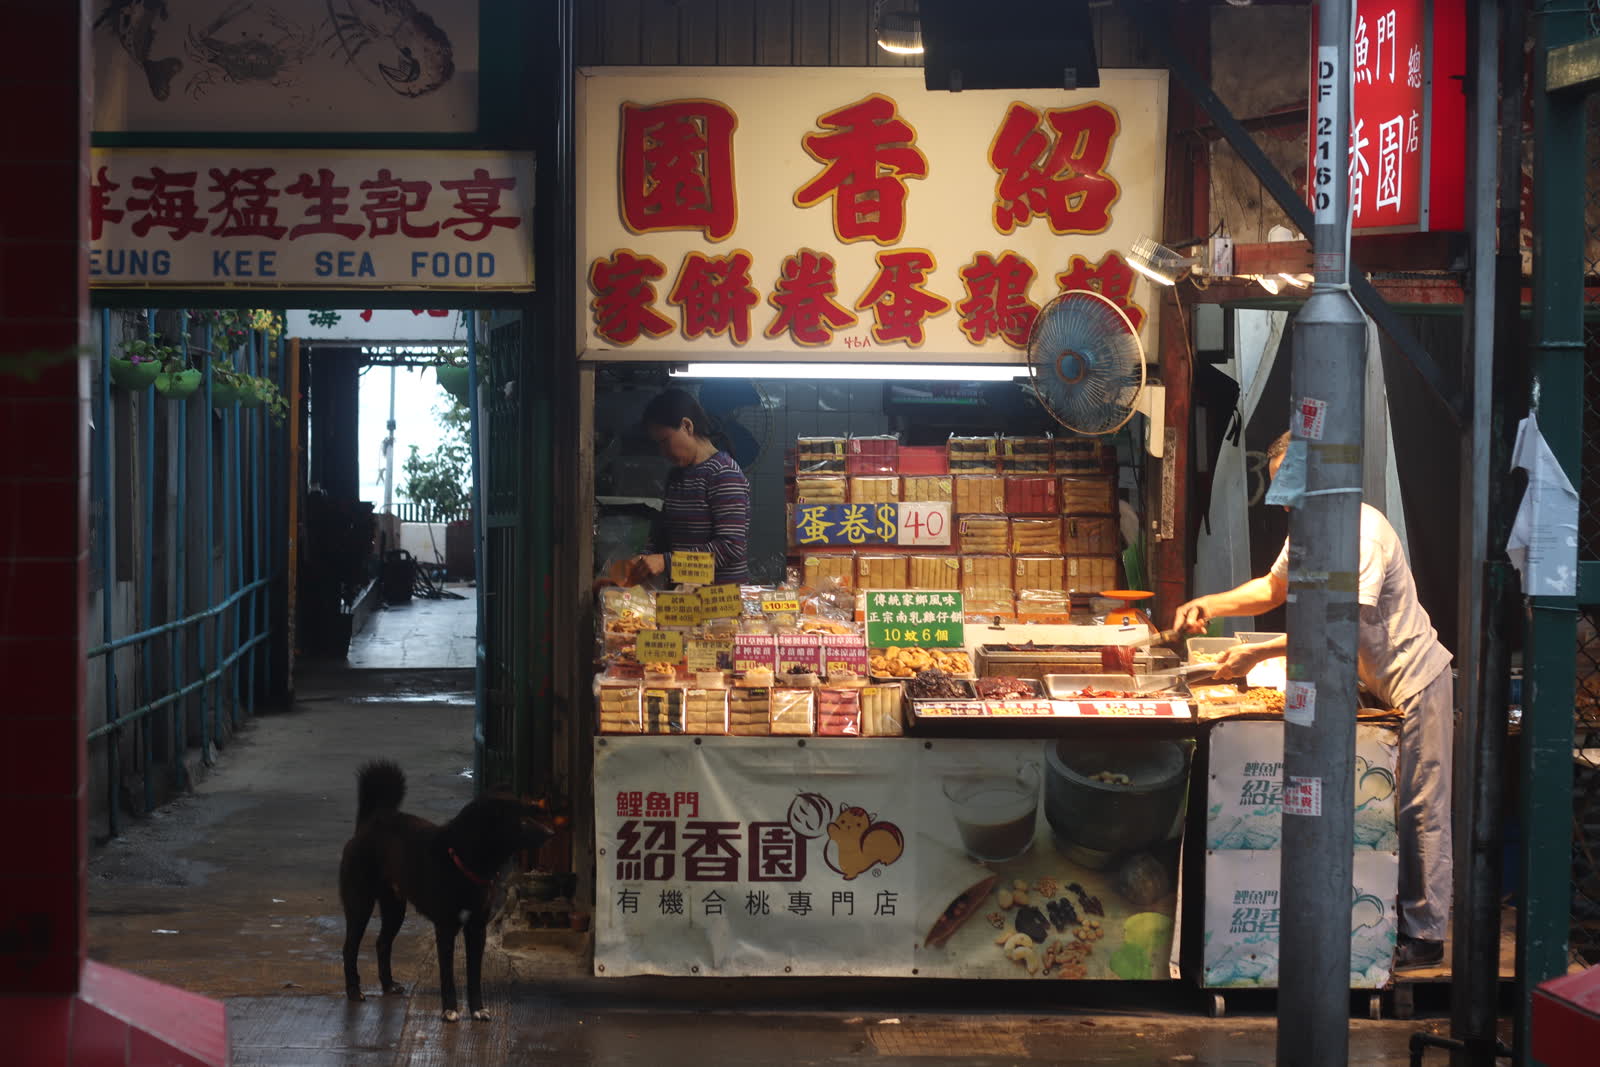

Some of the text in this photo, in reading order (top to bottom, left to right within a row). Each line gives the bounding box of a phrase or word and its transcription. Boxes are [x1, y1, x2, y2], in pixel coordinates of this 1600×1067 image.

[213, 250, 277, 277] KEE
[315, 251, 376, 278] SEA
[411, 251, 496, 278] FOOD
[873, 593, 956, 607] 傳統家鄉風味
[867, 610, 963, 624] 正宗南乳雞仔餅
[616, 791, 699, 818] 鯉魚門
[616, 820, 808, 882] 紹香園
[616, 889, 899, 916] 有機合桃專門店
